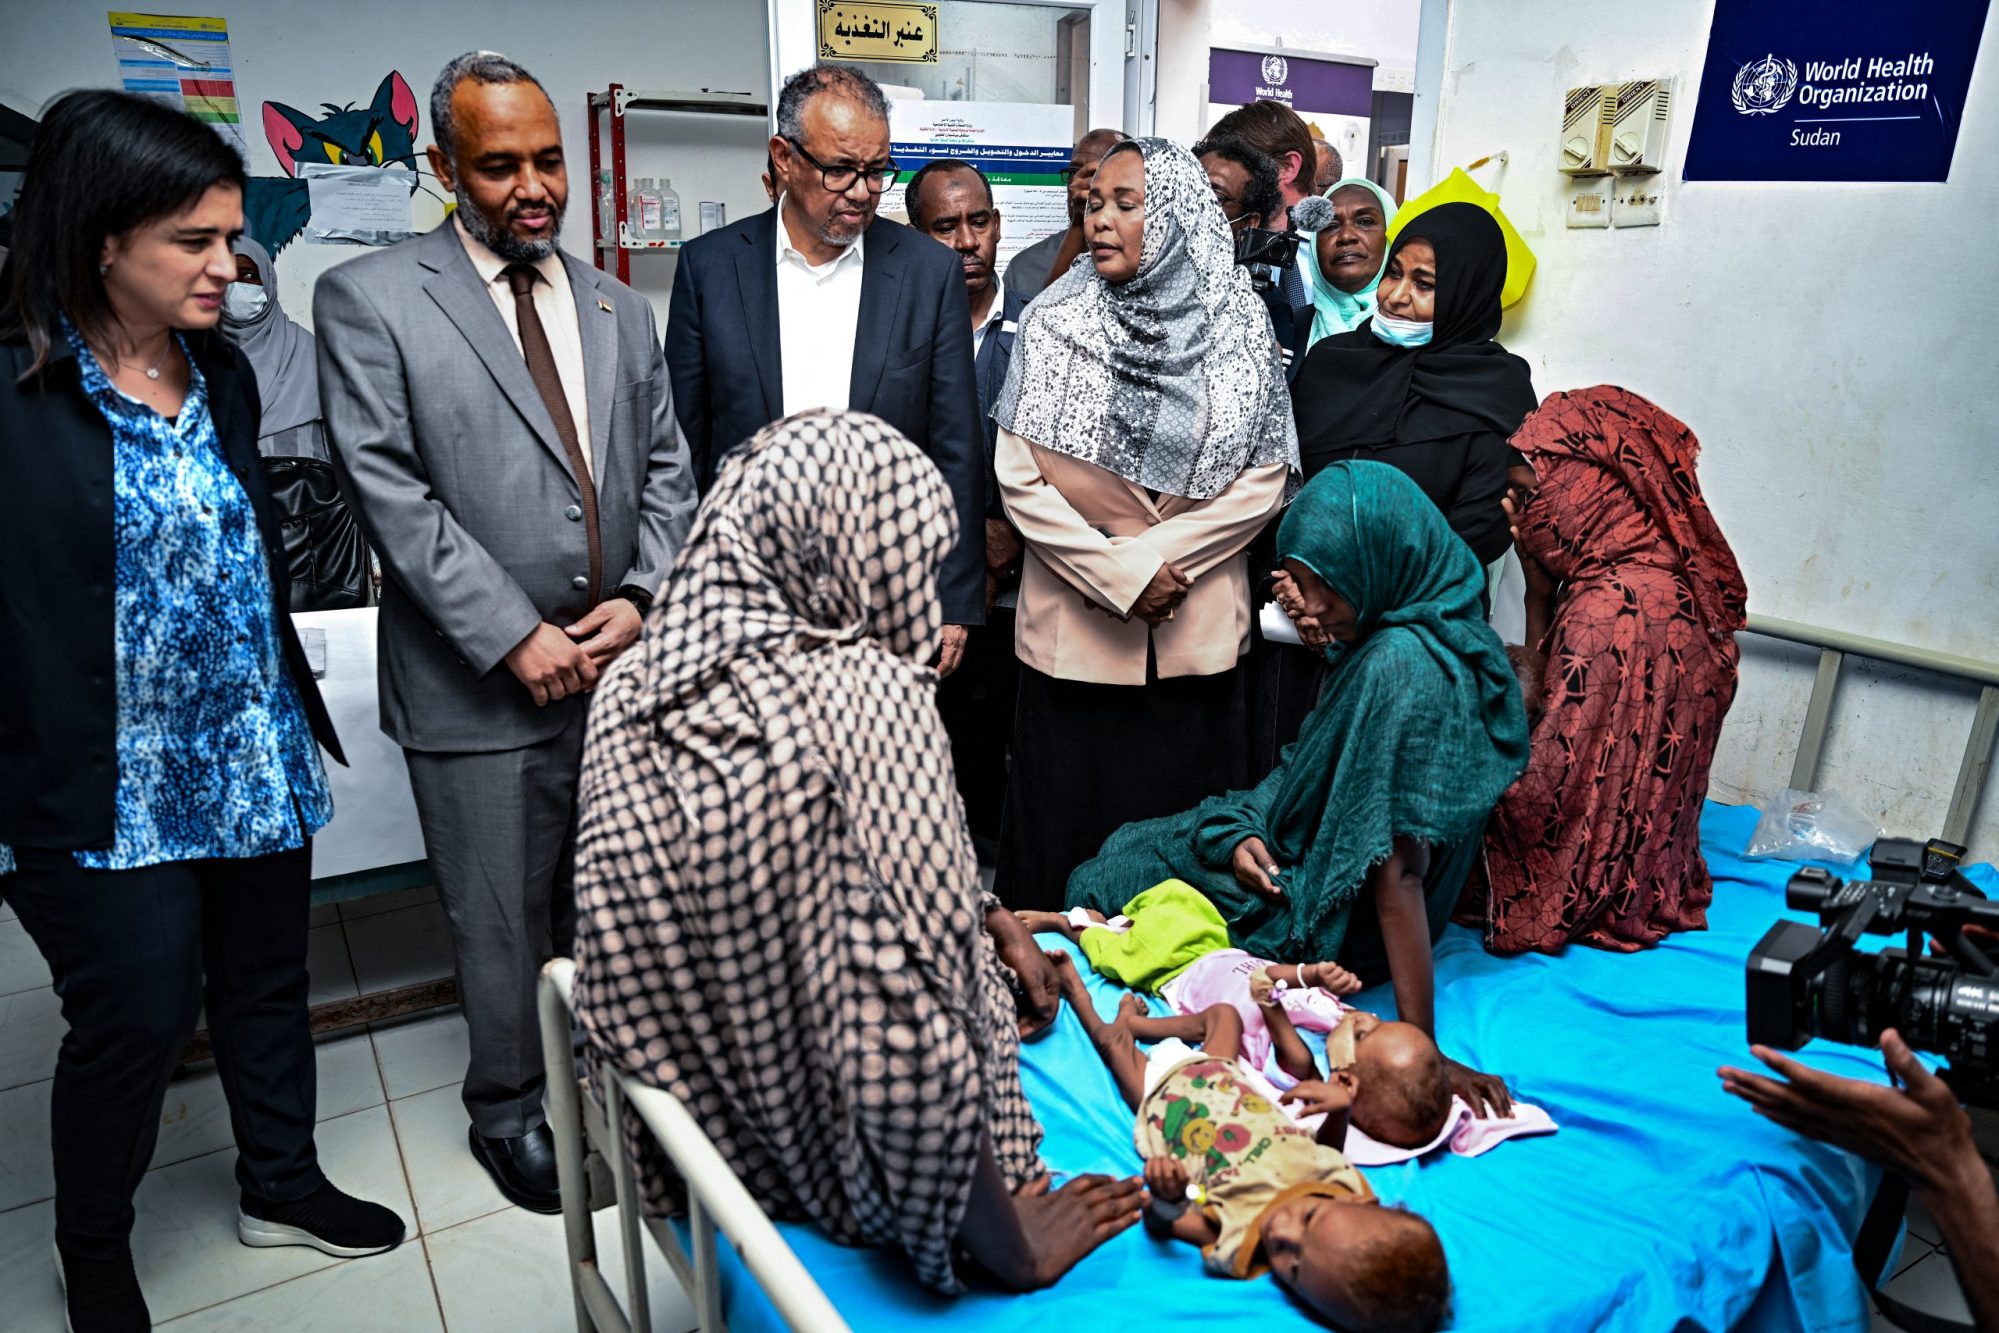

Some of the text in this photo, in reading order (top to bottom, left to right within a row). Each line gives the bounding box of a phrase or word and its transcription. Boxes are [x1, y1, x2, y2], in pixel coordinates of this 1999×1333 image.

[835, 11, 924, 48] عنبر التغذية
[1805, 52, 1934, 82] World Health
[1255, 86, 1293, 98] World Health
[1570, 89, 1592, 109] ORIENT
[1622, 83, 1645, 103] ORIENT
[1798, 80, 1928, 109] Organization
[1790, 127, 1841, 147] Sudan
[892, 145, 927, 154] التغذية
[928, 146, 949, 155] لسوء
[949, 147, 979, 155] والخروج
[979, 147, 1013, 156] والتحويل
[1013, 148, 1039, 157] الدخول
